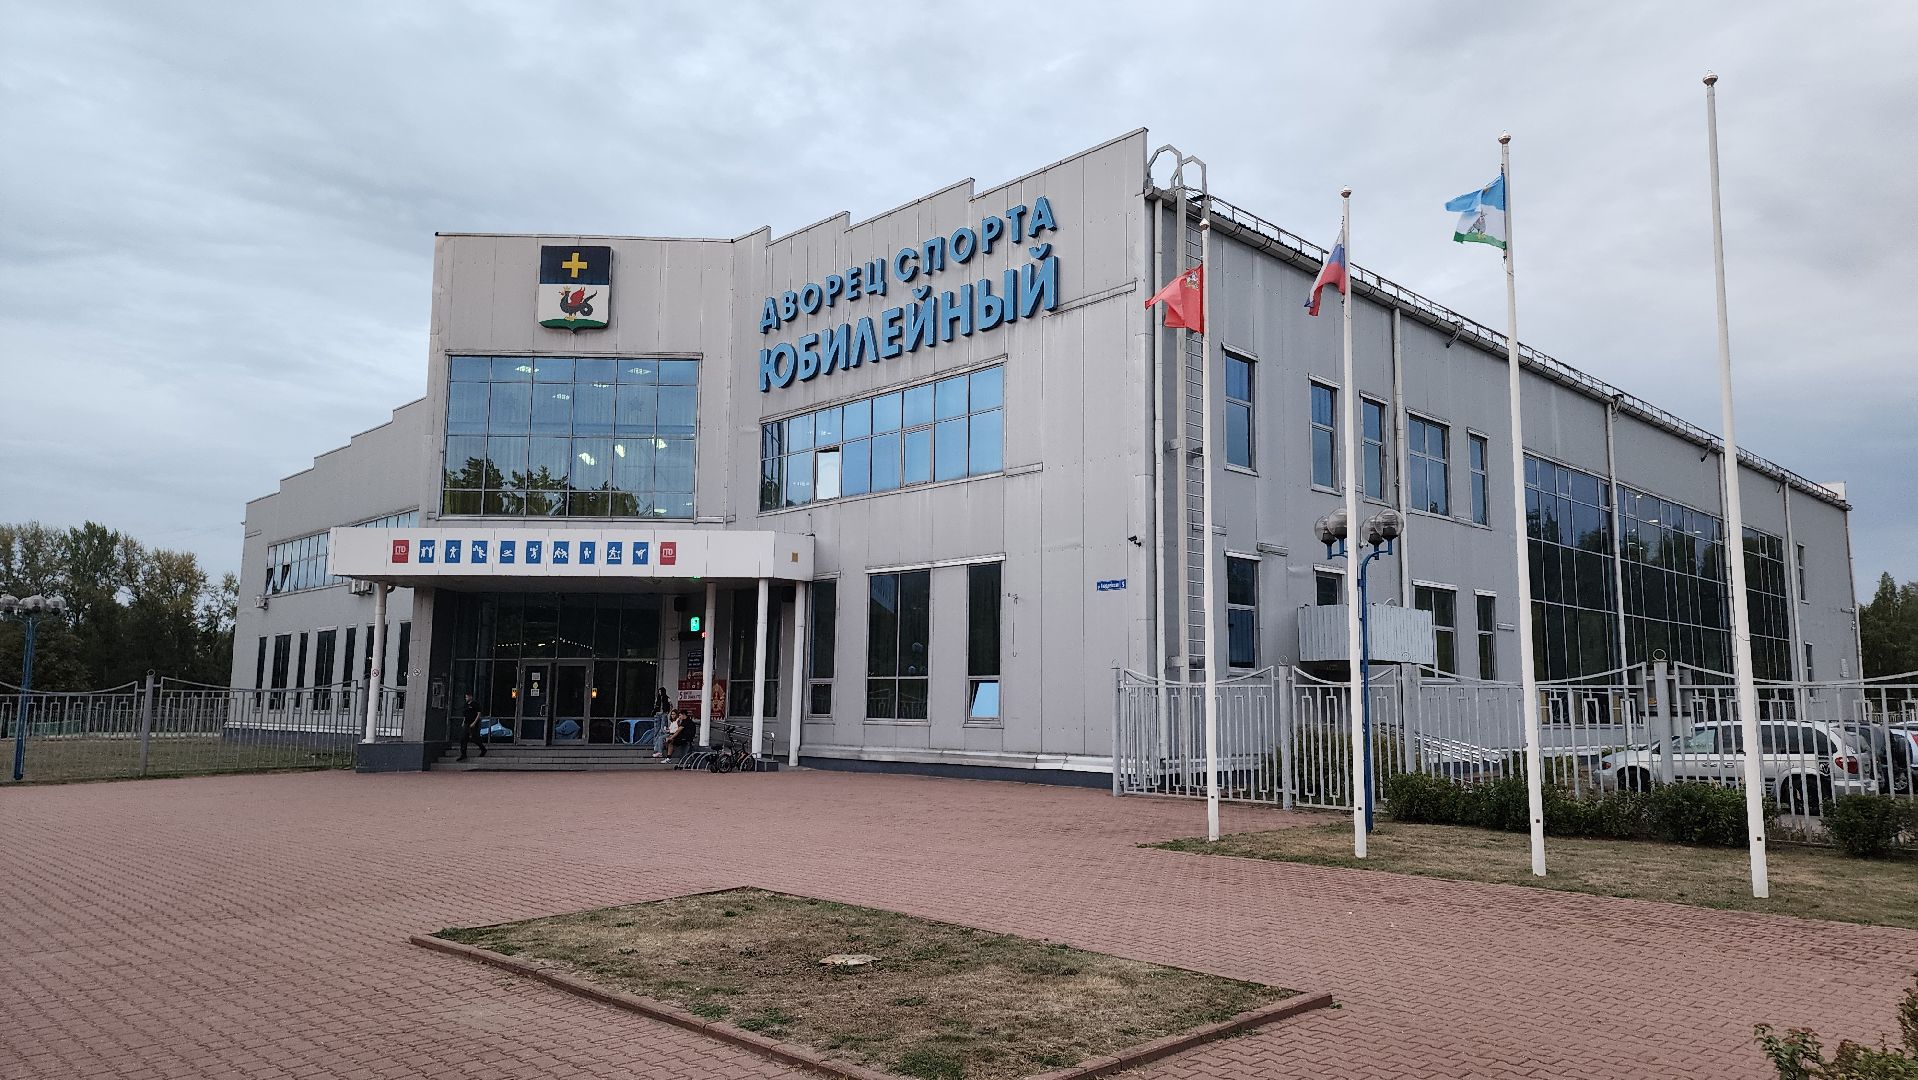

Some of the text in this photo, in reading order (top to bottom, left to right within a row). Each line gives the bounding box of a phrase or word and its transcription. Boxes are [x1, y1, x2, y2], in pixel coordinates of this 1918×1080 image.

[760, 196, 1058, 334] ДВОРЕЦ СПОРТА
[760, 243, 1059, 392] ЮБИЛЕЙНЫЙ
